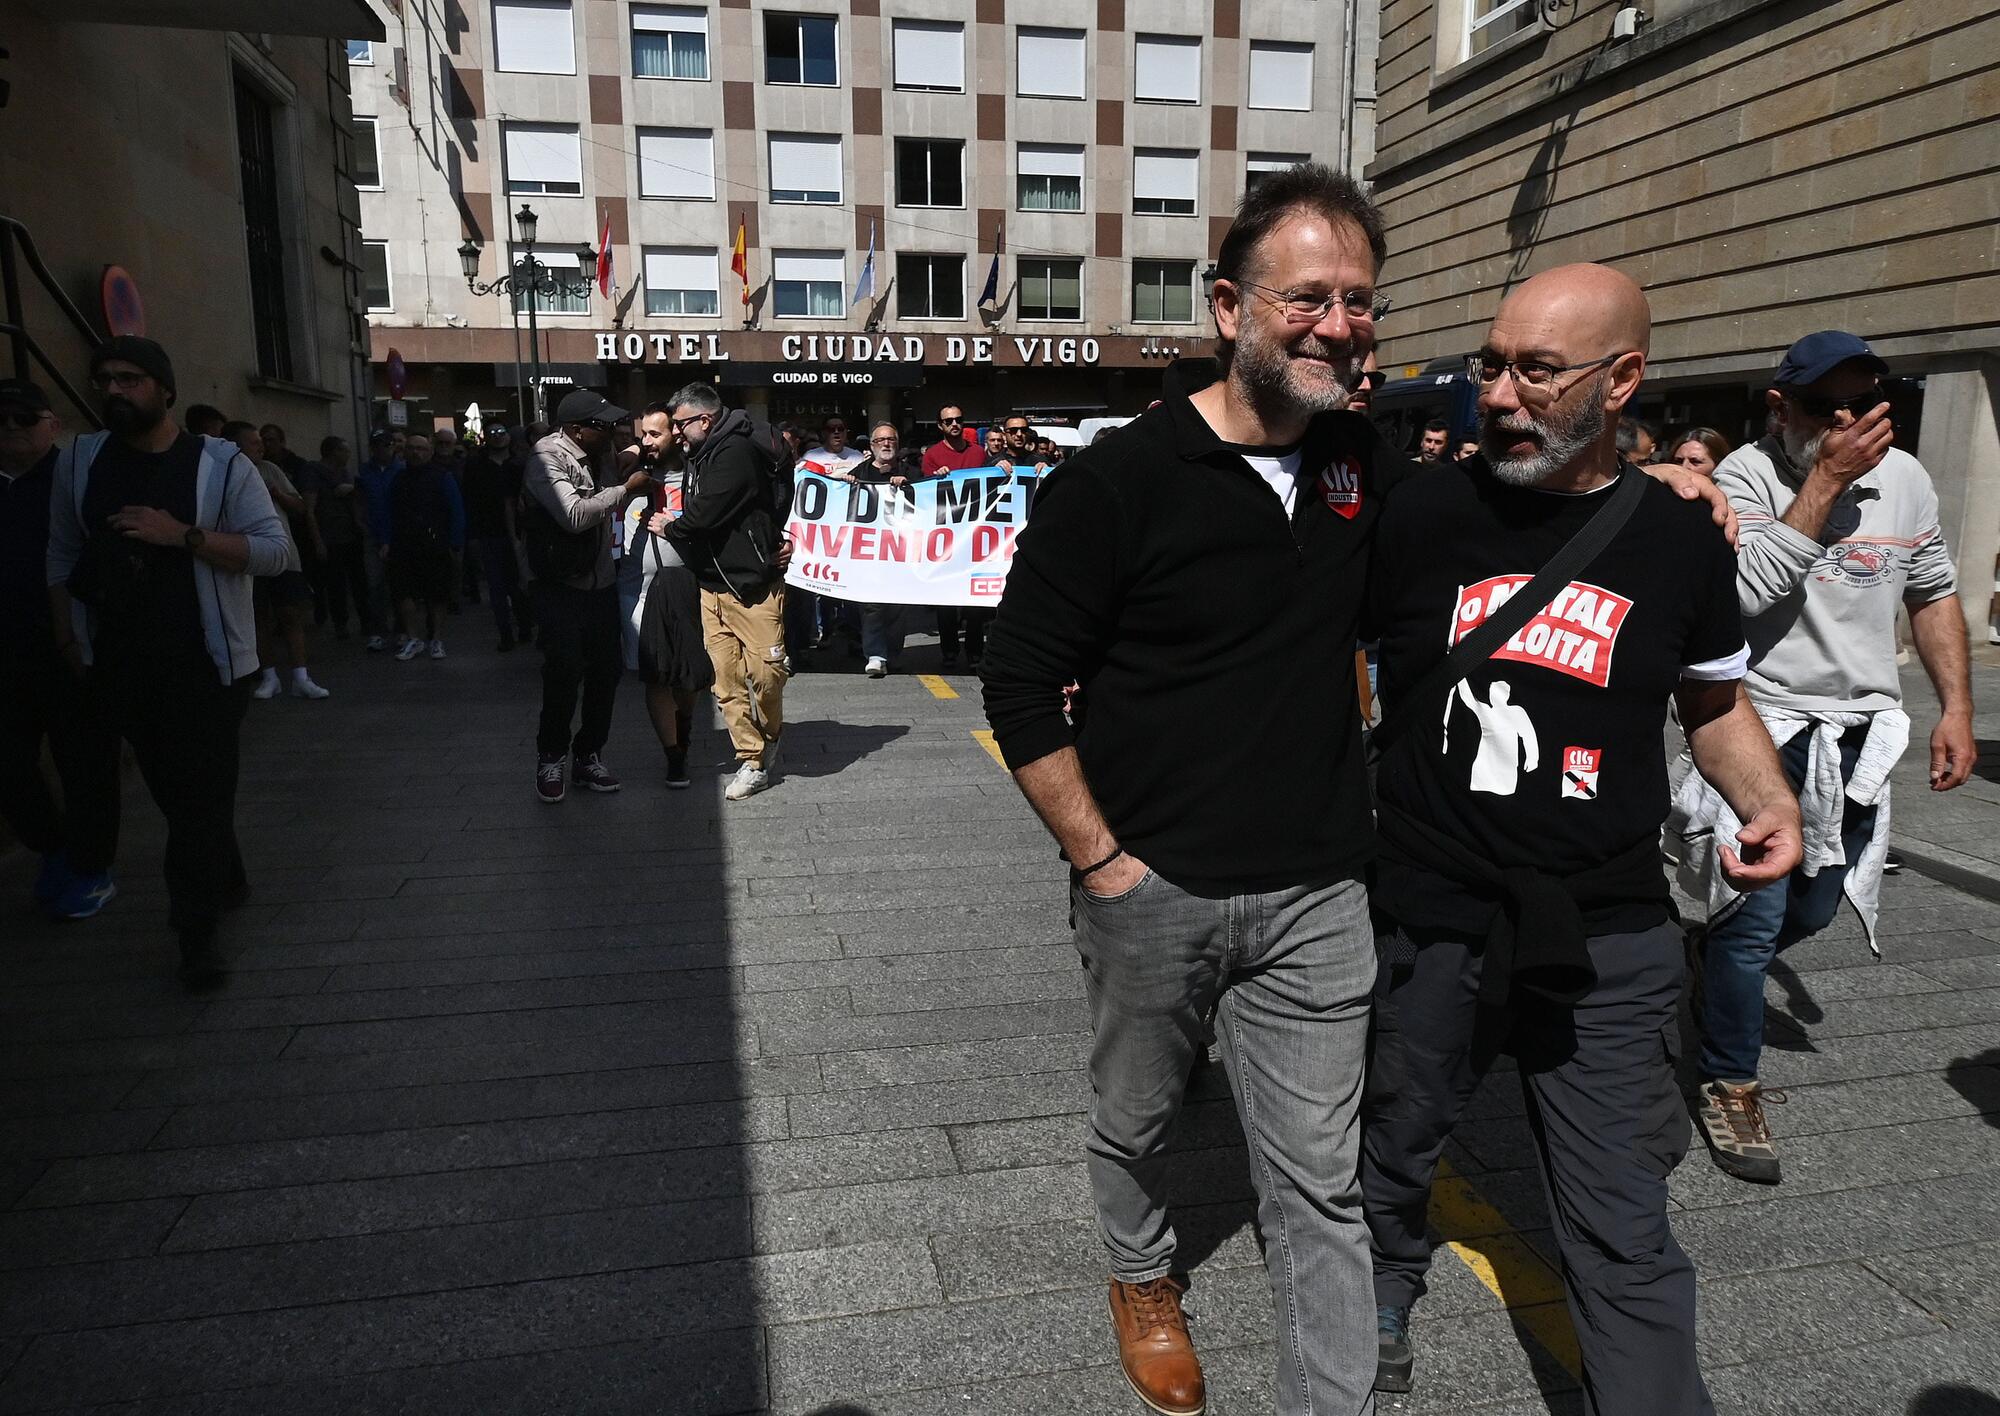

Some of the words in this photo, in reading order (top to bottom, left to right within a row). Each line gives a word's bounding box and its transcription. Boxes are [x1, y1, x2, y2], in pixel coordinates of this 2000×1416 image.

[595, 333, 729, 361] HOTEL
[781, 335, 925, 363] CIUDAD
[946, 337, 993, 362] DE
[1014, 338, 1100, 364] VIGO
[528, 376, 574, 385] CFETERIA
[772, 373, 818, 384] CIUDAD
[822, 373, 838, 384] DE
[842, 373, 873, 384] VIGO
[1321, 462, 1359, 491] CIG
[846, 484, 916, 527] DO
[802, 562, 840, 582] CIG
[1460, 597, 1482, 622] O
[1485, 581, 1617, 639] MTAL
[1507, 623, 1599, 674] LOITA
[1570, 750, 1594, 765] CIG
